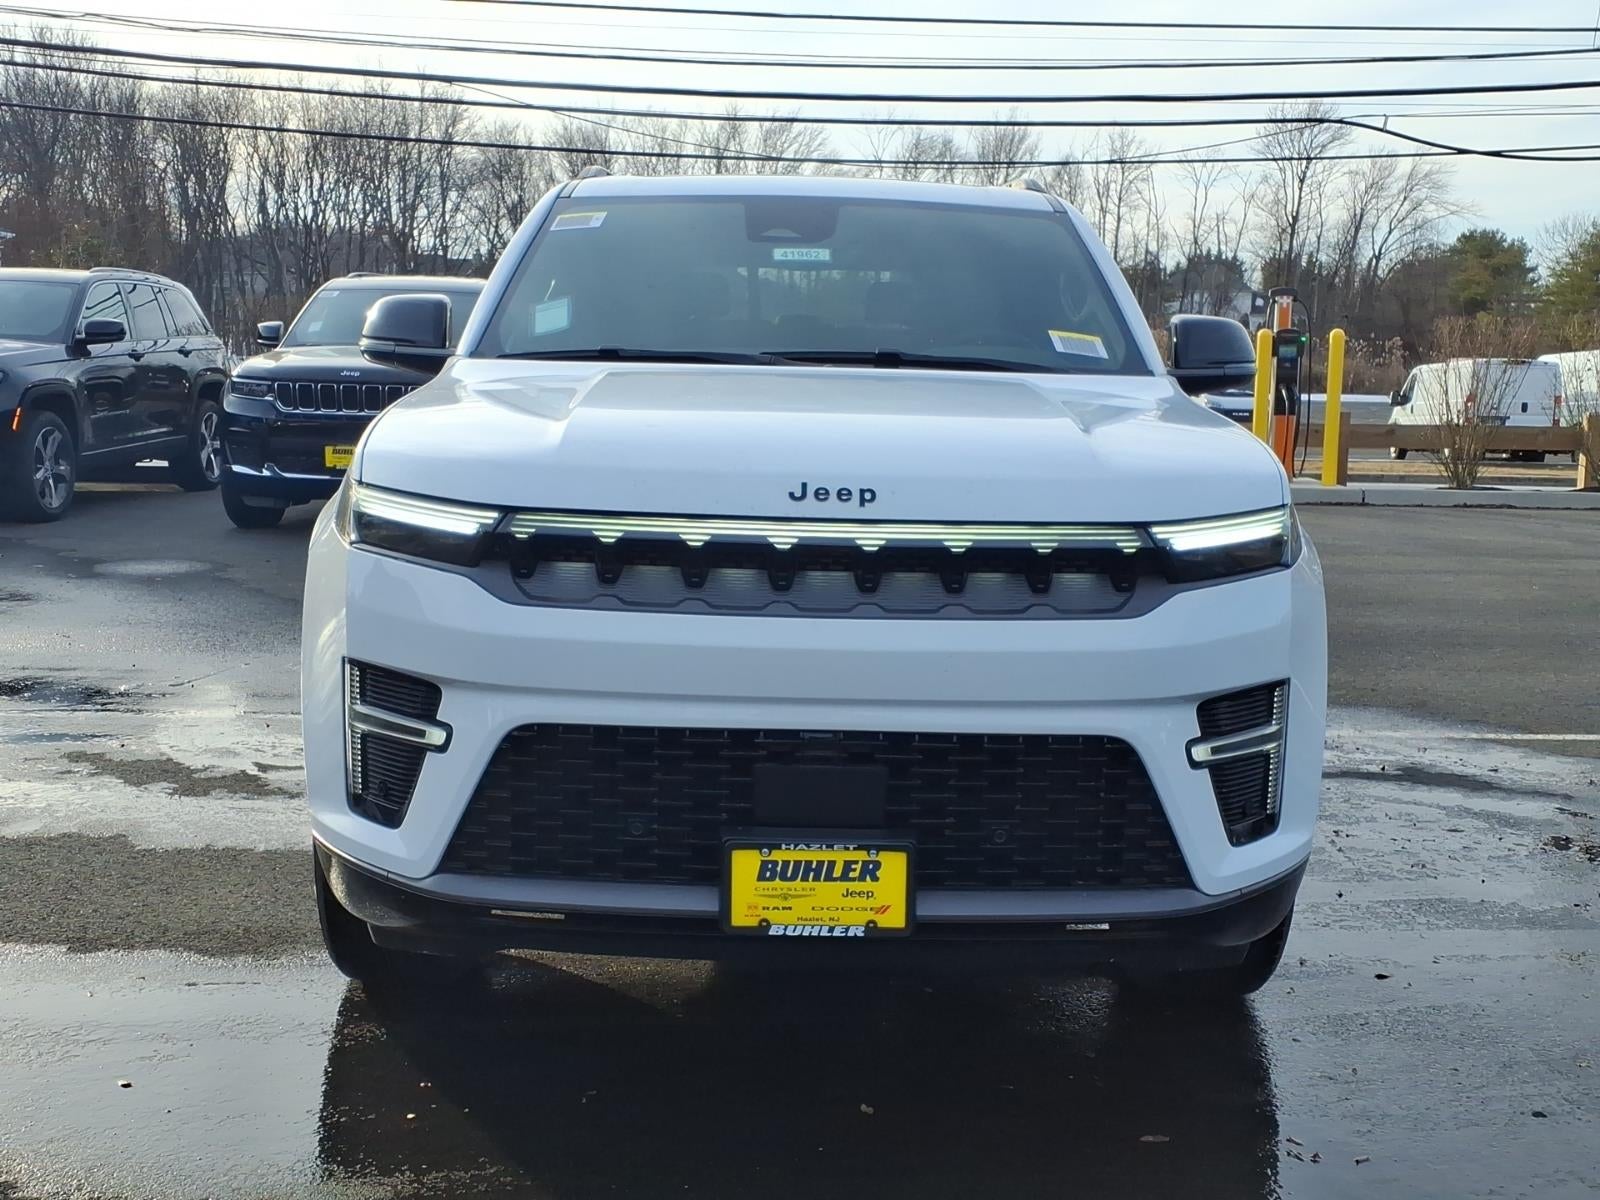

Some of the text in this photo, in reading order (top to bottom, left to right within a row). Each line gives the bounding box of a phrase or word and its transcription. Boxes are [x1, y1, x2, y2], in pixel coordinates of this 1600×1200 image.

[788, 481, 877, 507] Jeep
[781, 843, 859, 851] HAZLET
[756, 859, 882, 883] BUHLER
[841, 888, 875, 900] Jeep
[768, 925, 865, 936] BUHLER
